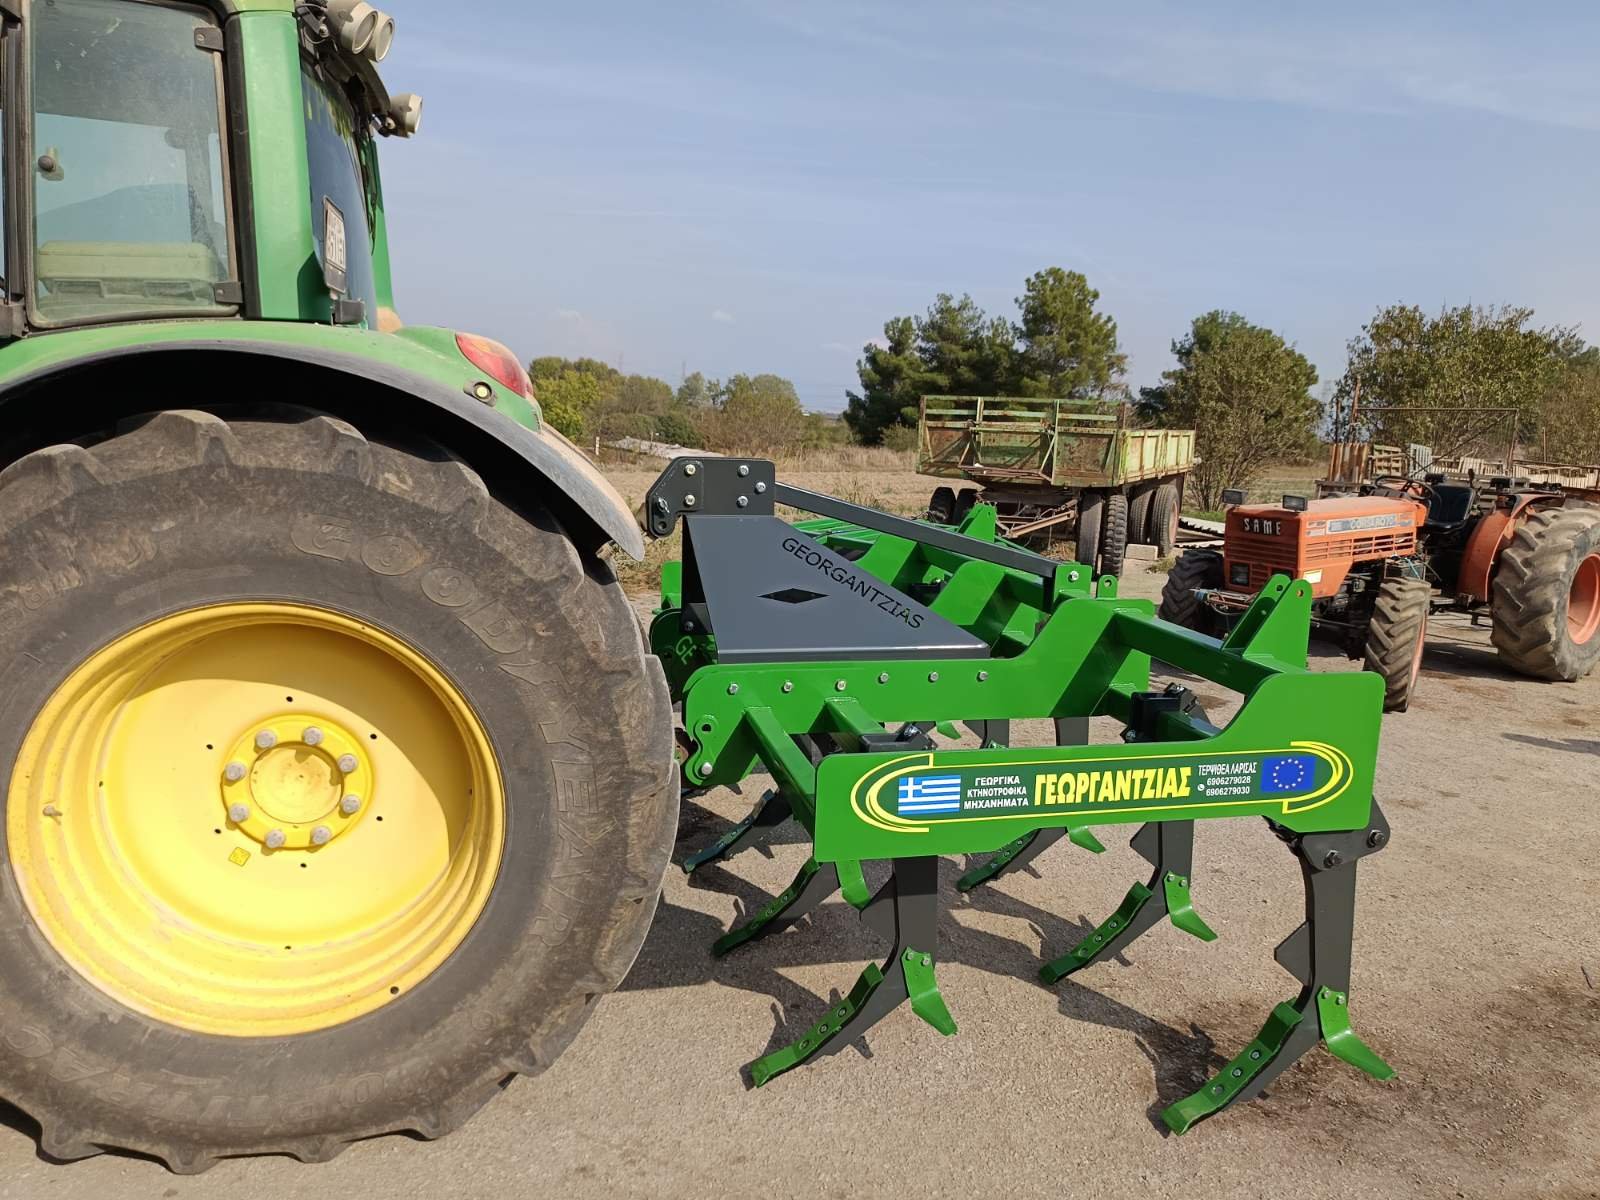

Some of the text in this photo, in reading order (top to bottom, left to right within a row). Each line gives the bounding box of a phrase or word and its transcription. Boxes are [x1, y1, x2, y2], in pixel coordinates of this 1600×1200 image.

[1243, 518, 1281, 536] SAME
[782, 537, 925, 629] GEORGANTZIAS
[1198, 763, 1230, 776] ΤΕΡΨΙΘΕΑ
[975, 776, 1020, 786] ΓΕΩΡΓΙΚΑ
[1034, 766, 1192, 806] ΓΕΩΡΓΑΝΤΖΙΑΣ
[967, 786, 1027, 798] ΚΤΗΝΟΤΡΟΦΙΚΑ
[964, 798, 1029, 810] ΜΗΧΑΝΗΜΑΤΑ
